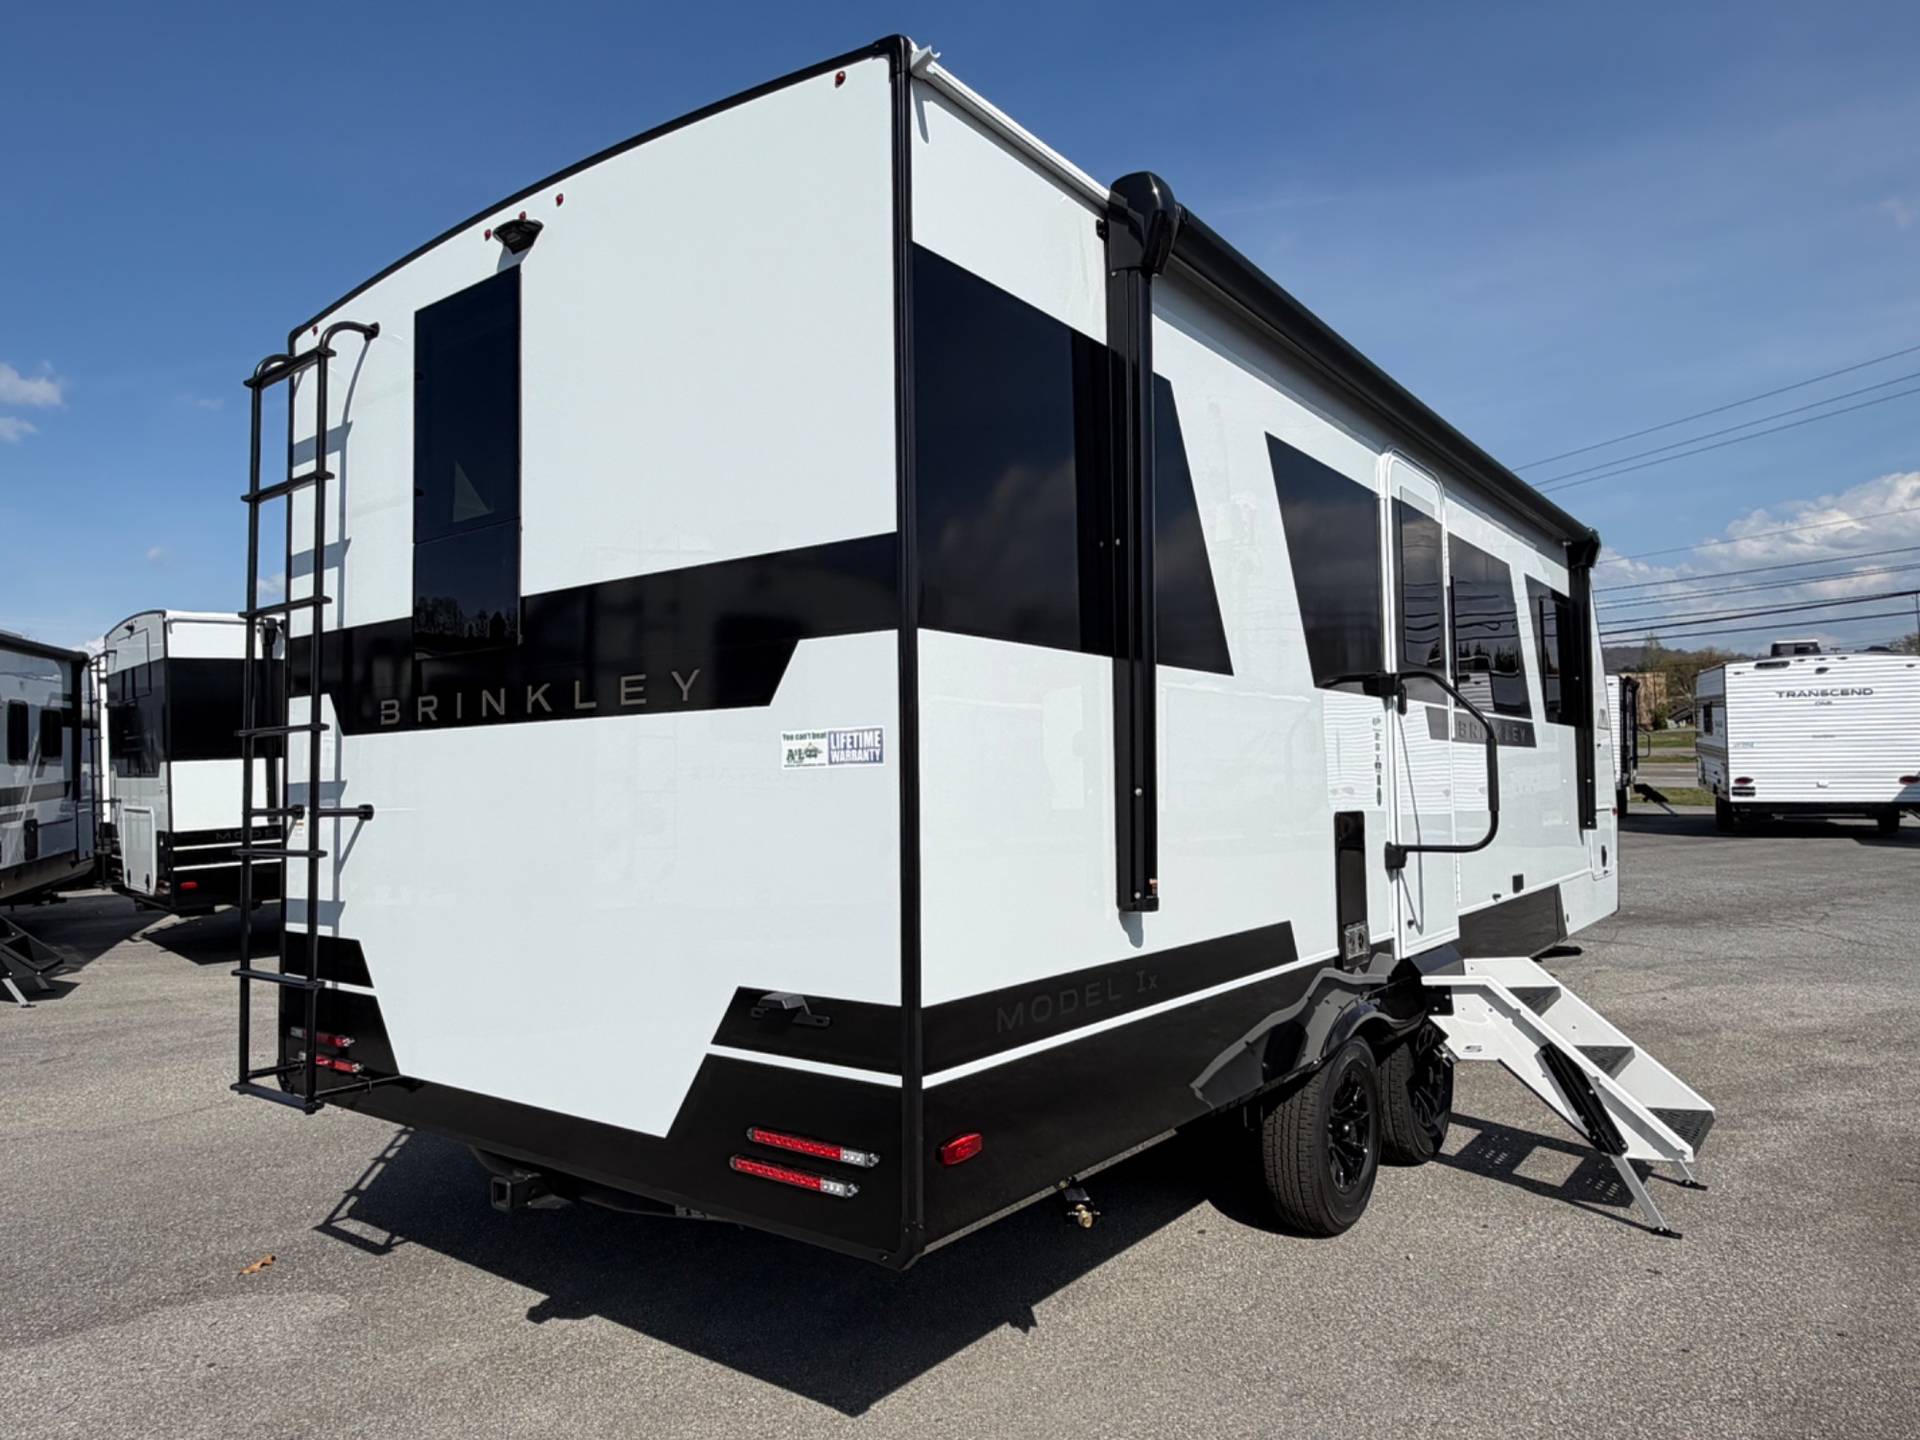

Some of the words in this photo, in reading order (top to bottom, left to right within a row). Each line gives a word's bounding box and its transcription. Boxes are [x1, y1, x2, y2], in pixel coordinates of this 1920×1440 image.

[380, 669, 700, 726] BRINKLEY
[1775, 687, 1874, 698] TRANSCEND
[830, 730, 881, 749] LIFETIME
[1457, 719, 1526, 742] BRIKLEY
[830, 748, 881, 763] WARRANTY
[215, 828, 273, 841] MODE
[996, 978, 1122, 1033] MODEL
